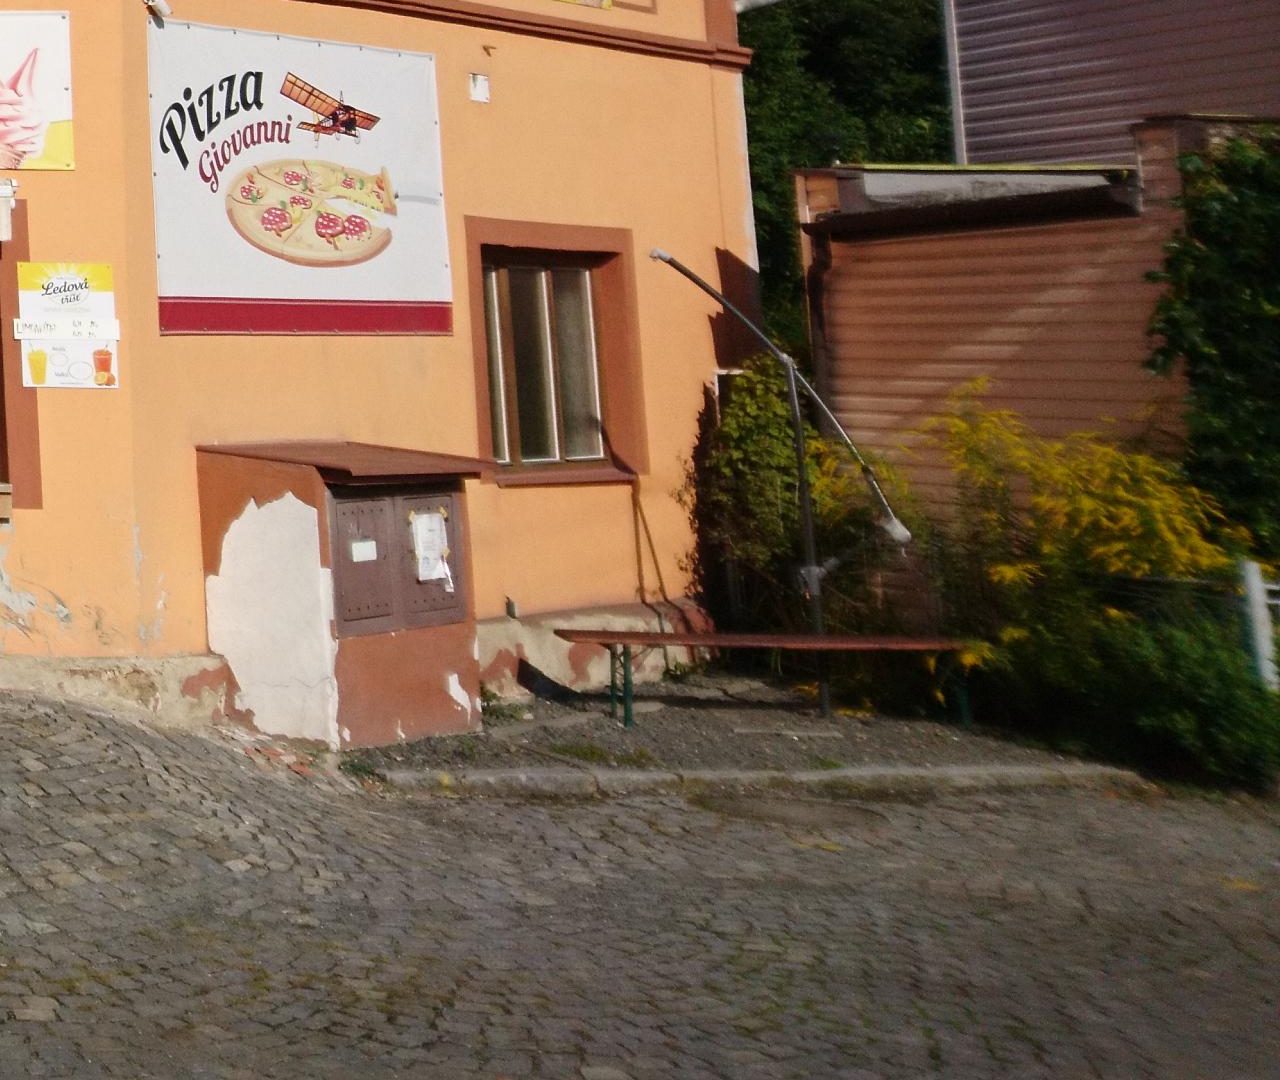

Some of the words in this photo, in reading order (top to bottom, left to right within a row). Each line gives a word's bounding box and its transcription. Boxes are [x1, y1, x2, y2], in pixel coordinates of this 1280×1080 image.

[159, 70, 264, 171] Pizza
[198, 114, 293, 194] Giovanni
[41, 277, 90, 297] Ledová
